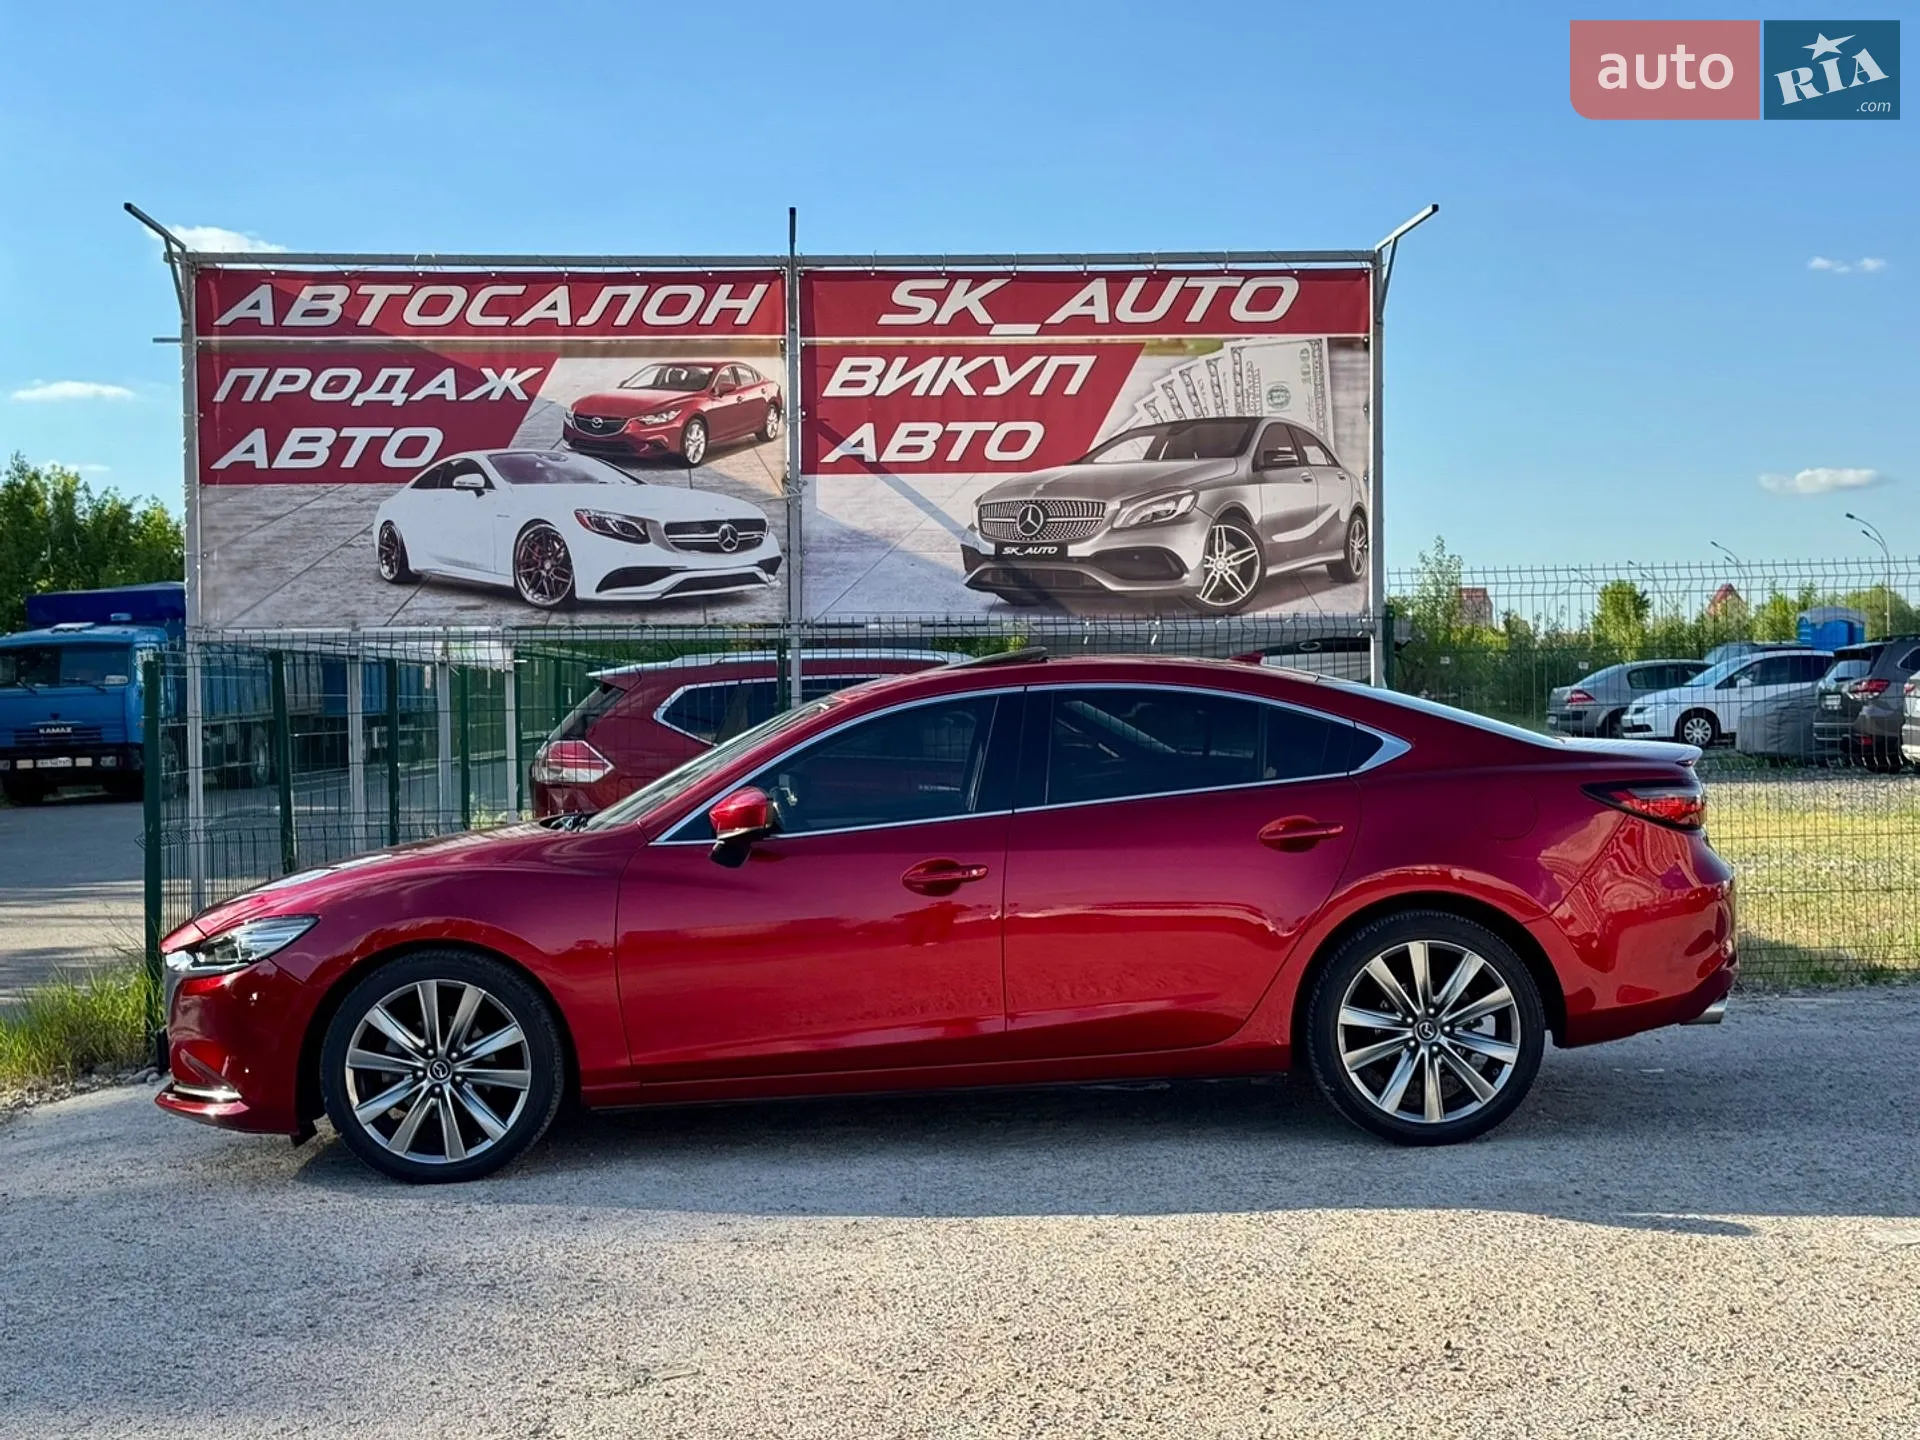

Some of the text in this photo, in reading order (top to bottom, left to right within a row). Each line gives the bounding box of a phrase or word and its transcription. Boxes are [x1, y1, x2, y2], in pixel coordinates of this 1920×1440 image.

[213, 283, 770, 328] АВТОСАЛОН
[878, 277, 1299, 335] SK_AUTO
[212, 366, 544, 406] ПРОДАЖ
[822, 355, 1098, 397] ВИКУП
[210, 426, 444, 470] АВТО
[819, 421, 1046, 464] АВТО
[1002, 546, 1058, 556] SK_AUTO
